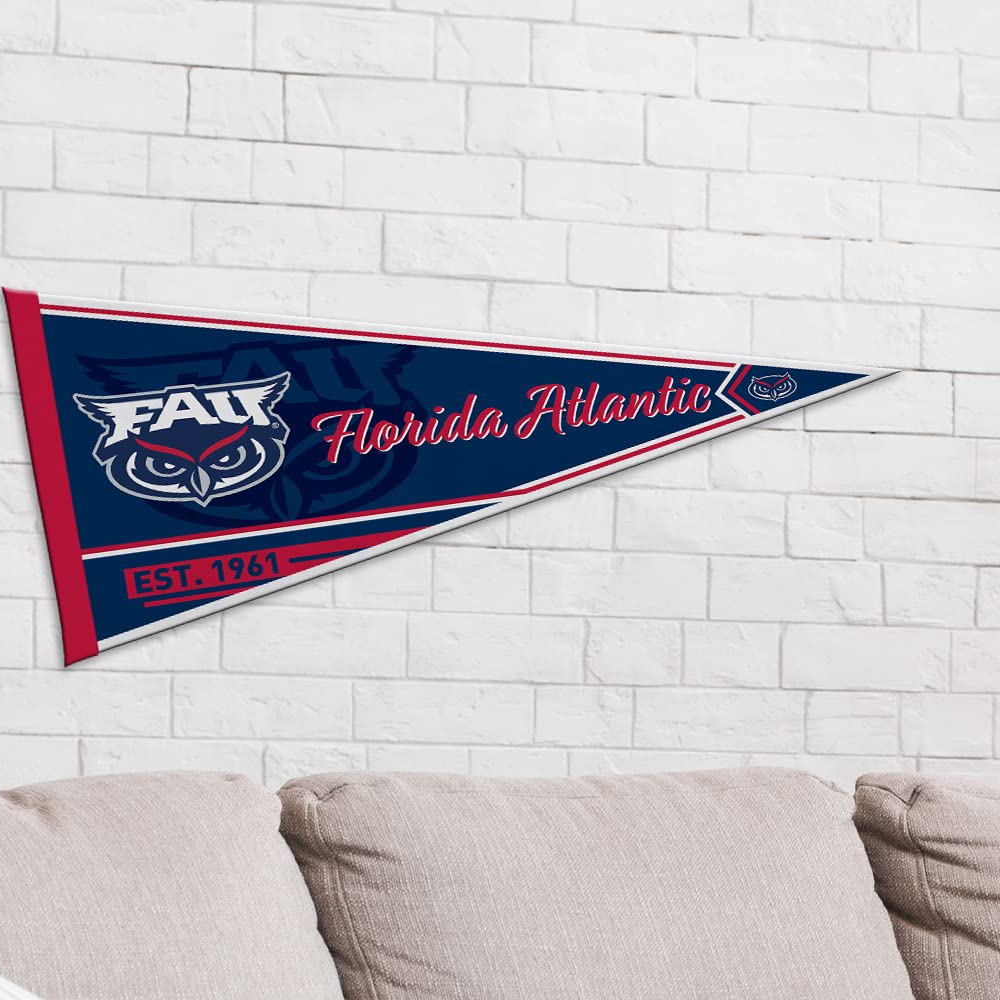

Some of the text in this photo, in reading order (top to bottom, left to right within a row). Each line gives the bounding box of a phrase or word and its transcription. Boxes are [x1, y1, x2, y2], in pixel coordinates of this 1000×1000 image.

[91, 384, 279, 448] FAU
[312, 376, 712, 463] Florida Atlantic
[133, 552, 281, 595] EST. 1961
